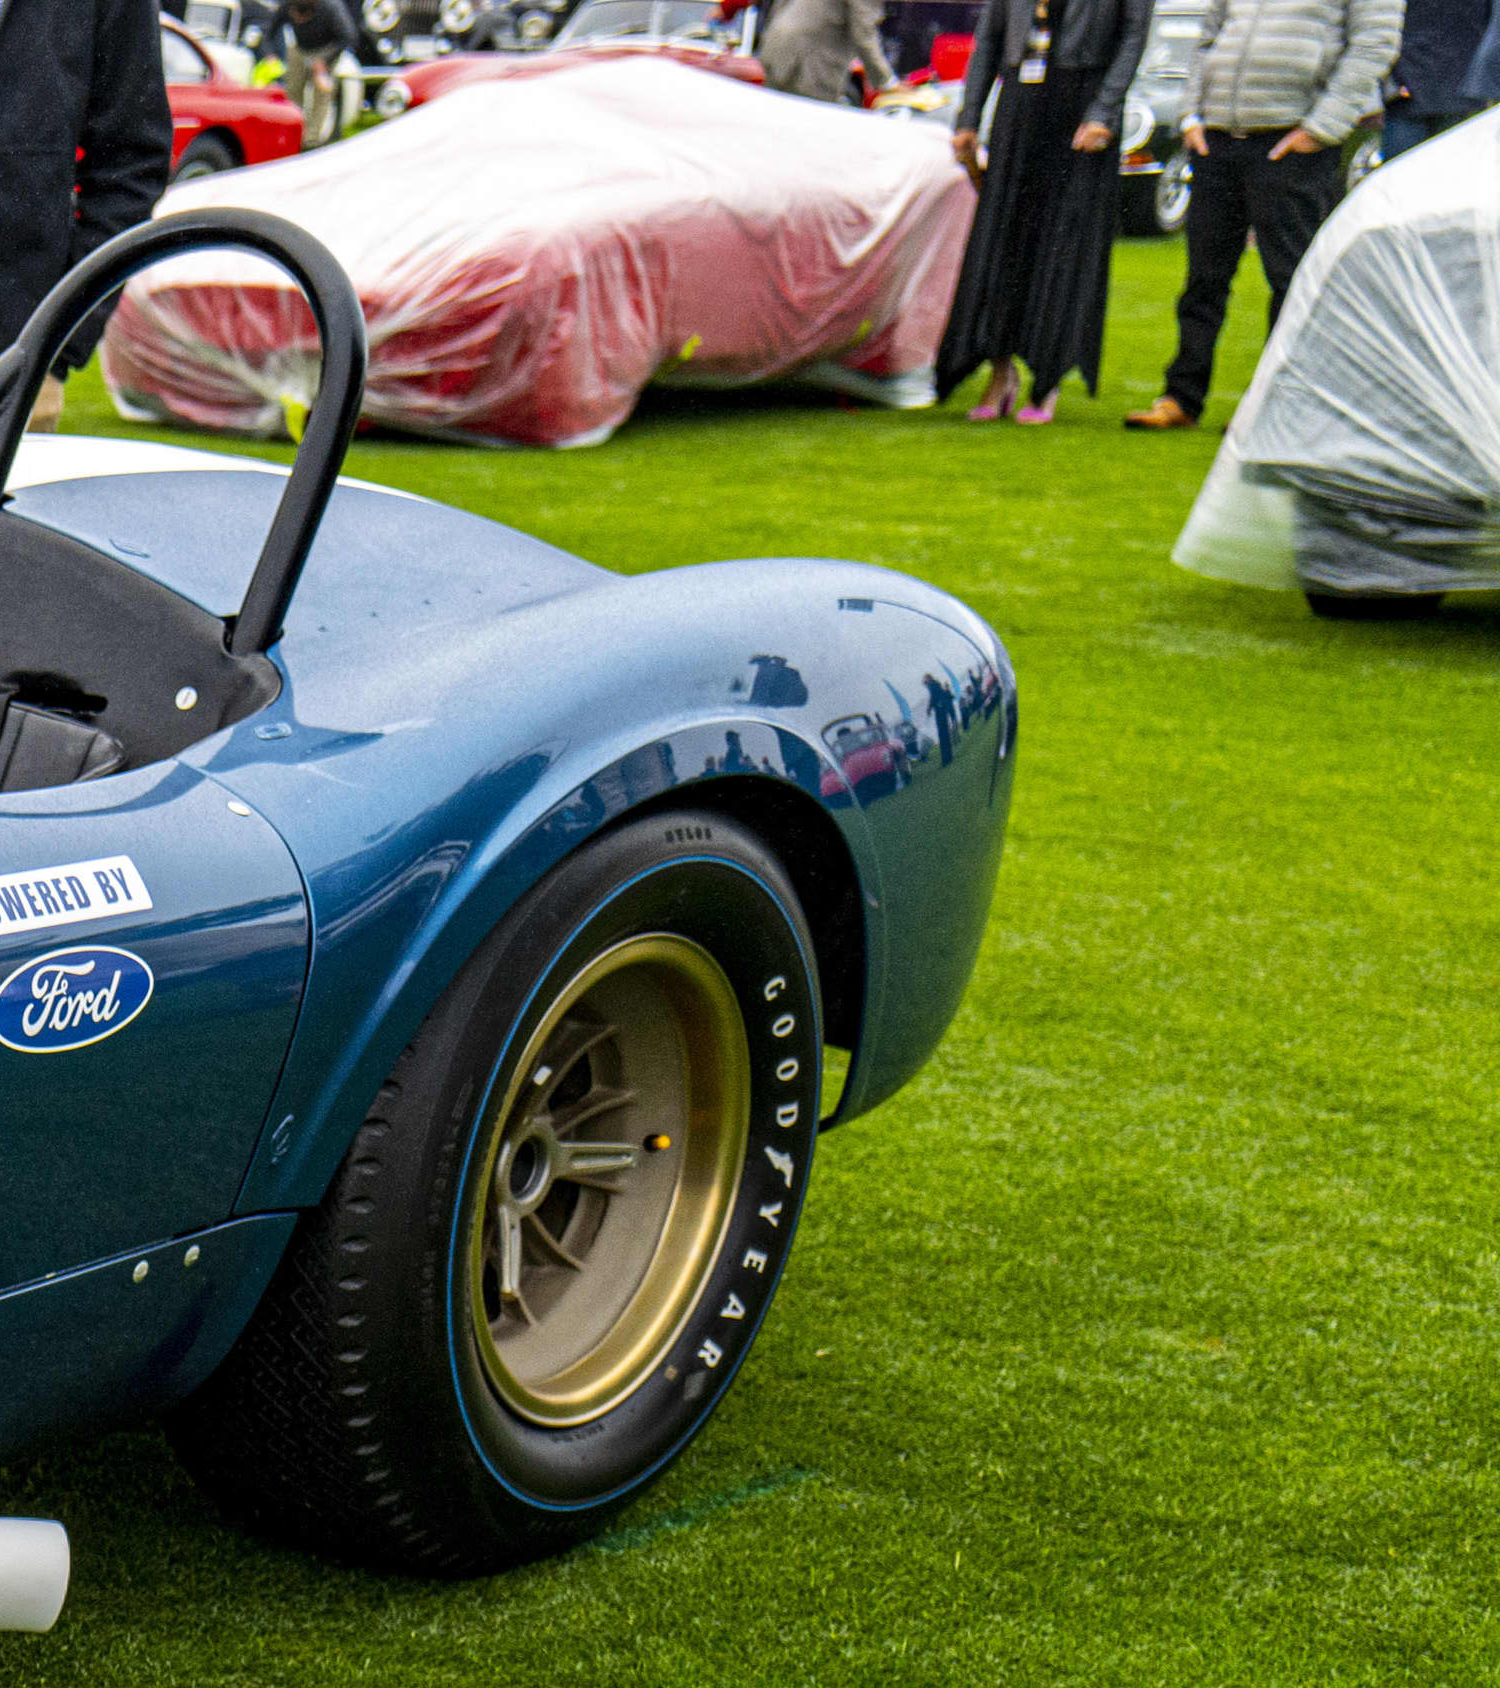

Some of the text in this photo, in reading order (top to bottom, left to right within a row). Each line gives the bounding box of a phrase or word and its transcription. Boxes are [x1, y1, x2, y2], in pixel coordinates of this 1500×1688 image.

[93, 867, 133, 904] BY
[22, 959, 121, 1037] Ford
[697, 975, 800, 1369] GOODYEAR
